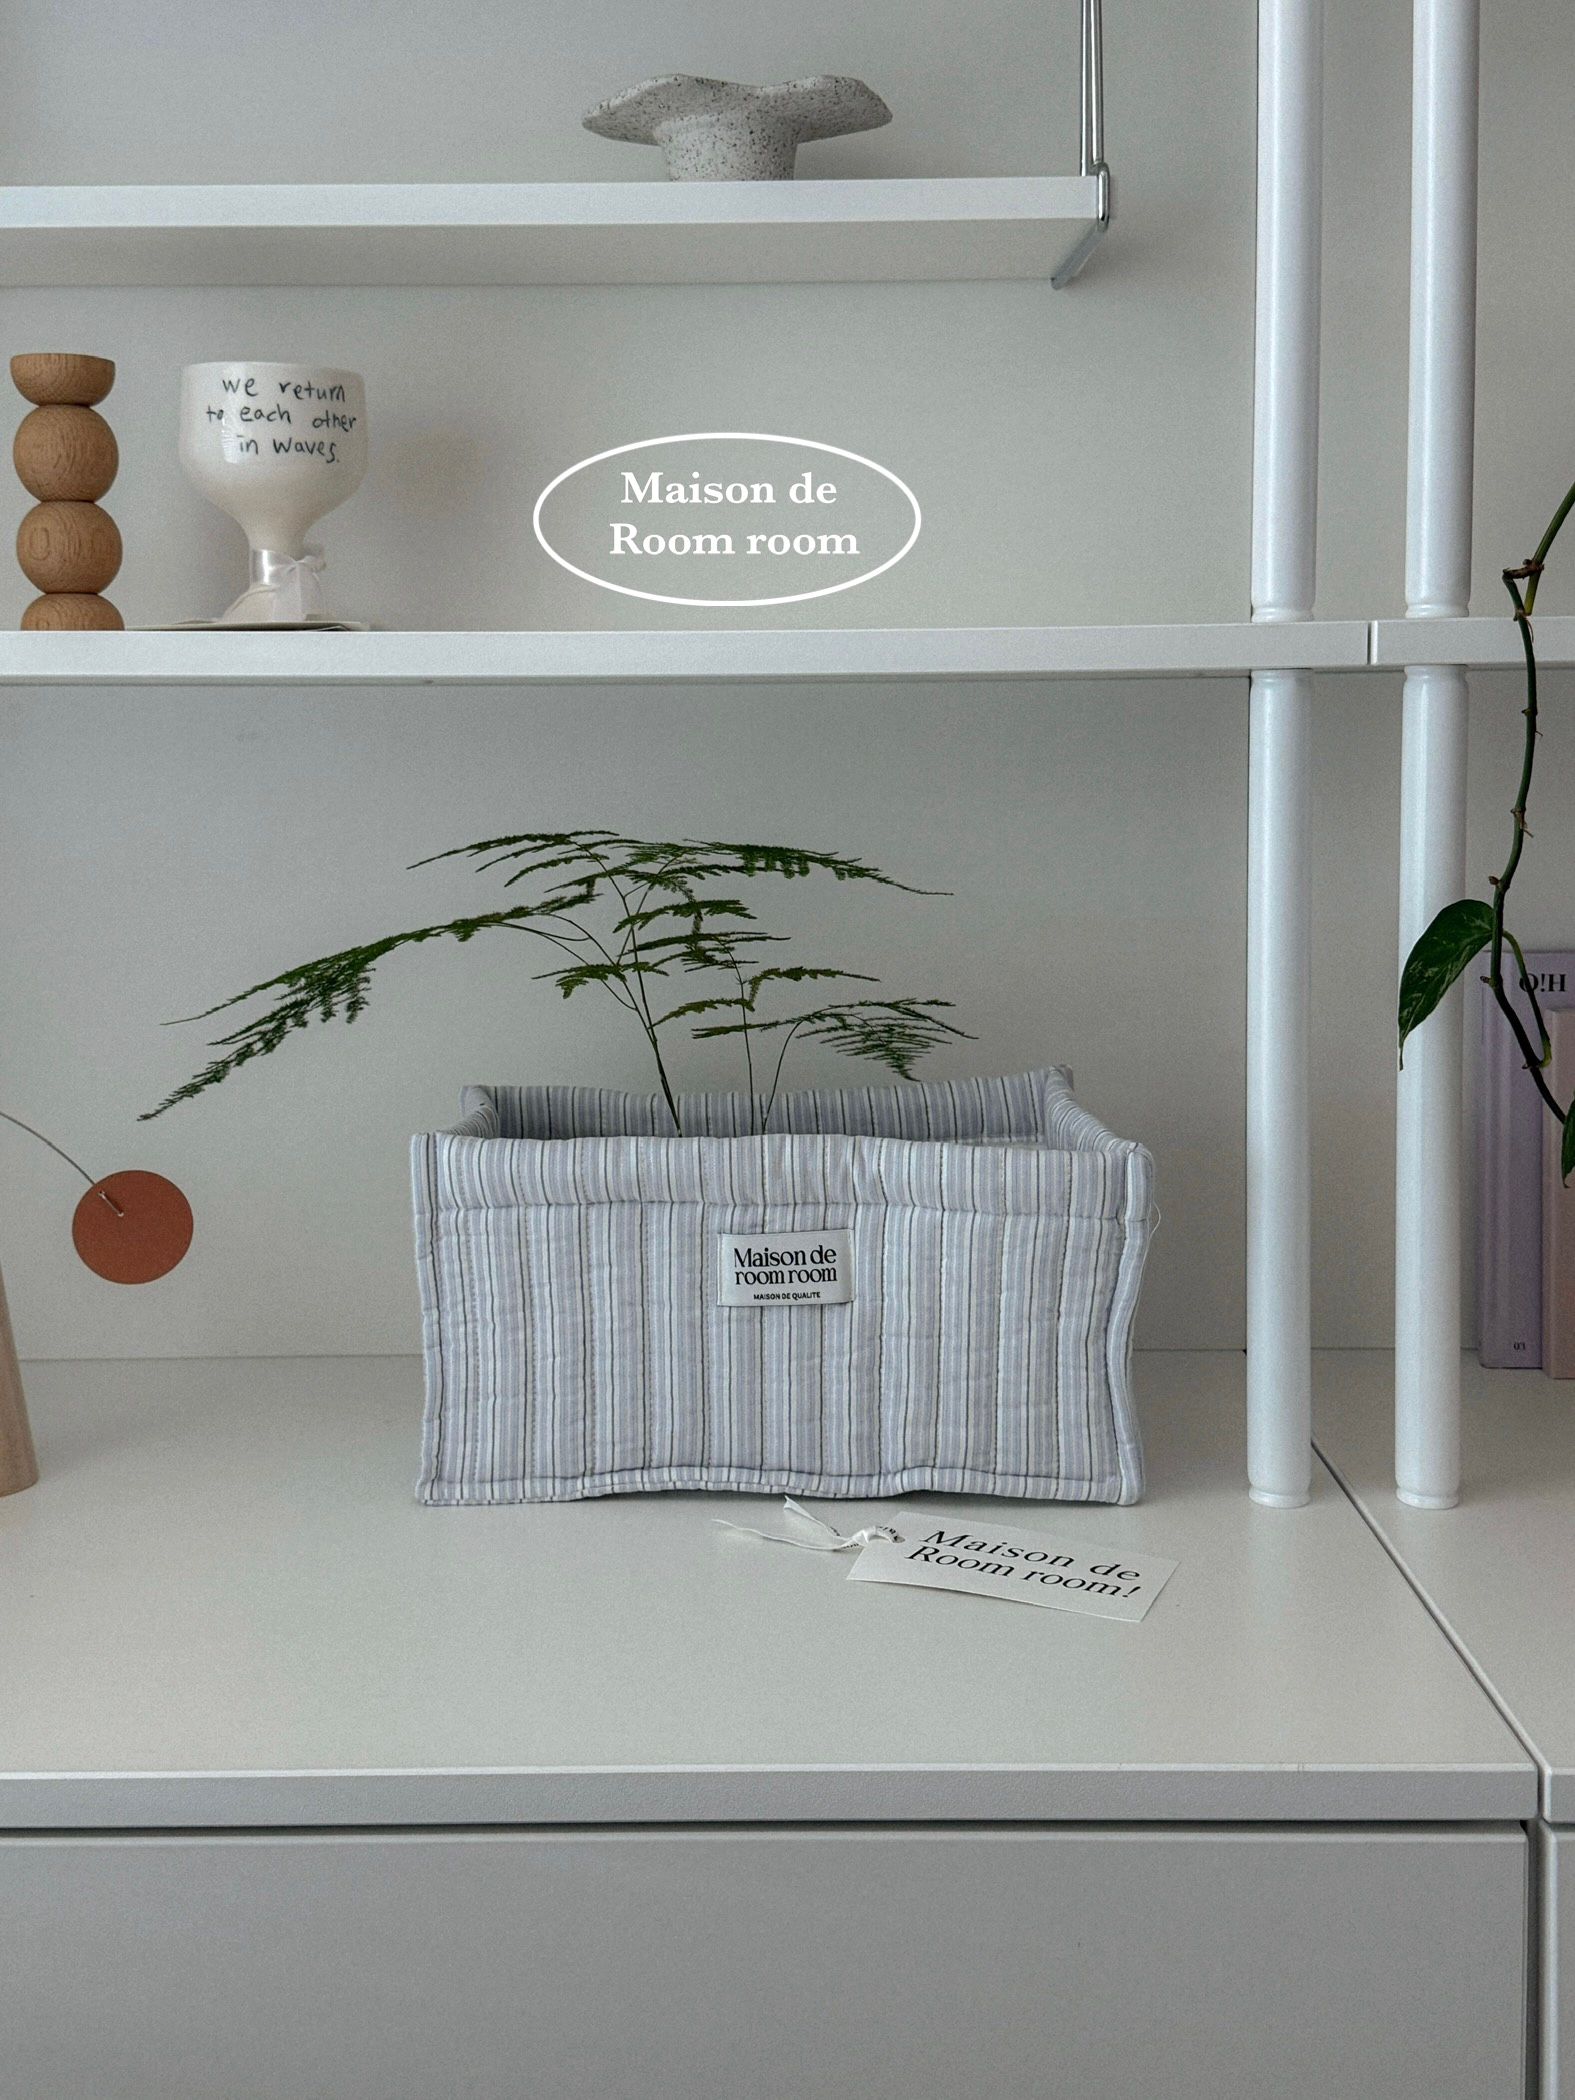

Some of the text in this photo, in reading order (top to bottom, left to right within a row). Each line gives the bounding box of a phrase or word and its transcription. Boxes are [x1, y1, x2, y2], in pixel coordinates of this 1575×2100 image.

[222, 378, 345, 402] we return
[206, 404, 356, 432] to each other
[236, 434, 258, 455] in
[734, 1245, 837, 1268] Maison de
[735, 1267, 837, 1285] room room
[921, 1530, 1075, 1567] Maison
[1089, 1563, 1141, 1581] de
[904, 1546, 1142, 1598] Room room!
